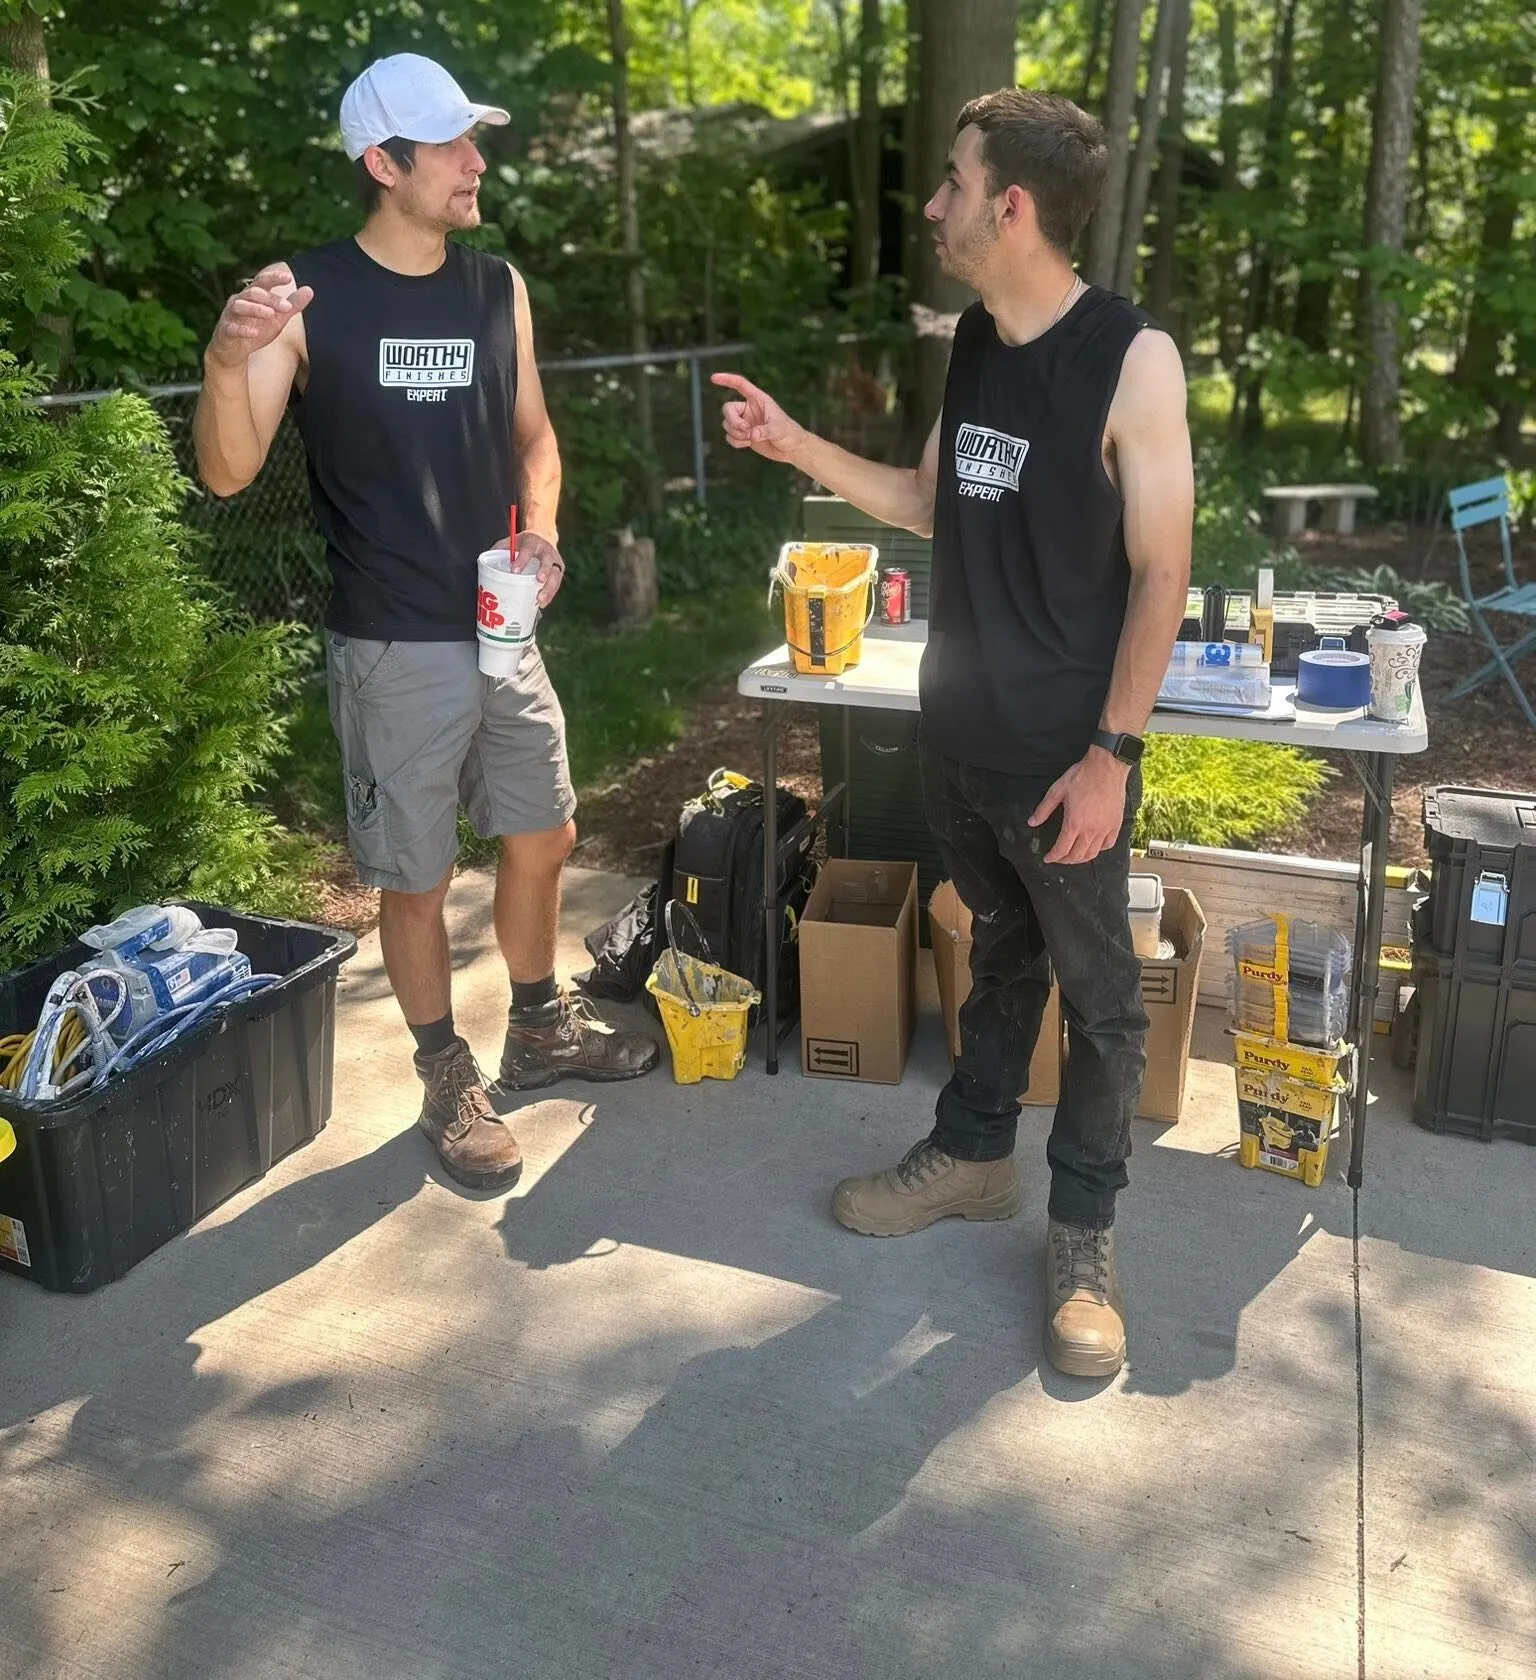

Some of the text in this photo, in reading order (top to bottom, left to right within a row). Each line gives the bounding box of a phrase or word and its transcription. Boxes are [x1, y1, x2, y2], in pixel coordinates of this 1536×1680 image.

[386, 344, 468, 369] WORTHY
[385, 370, 467, 380] FINISHES
[407, 388, 448, 402] EXPERT
[957, 430, 1022, 473] WORTHY
[957, 459, 1018, 484] INISHES
[958, 481, 1005, 502] EXPERT
[477, 584, 499, 611] IG
[1242, 965, 1284, 982] Purdy
[1243, 1050, 1291, 1071] Purdy
